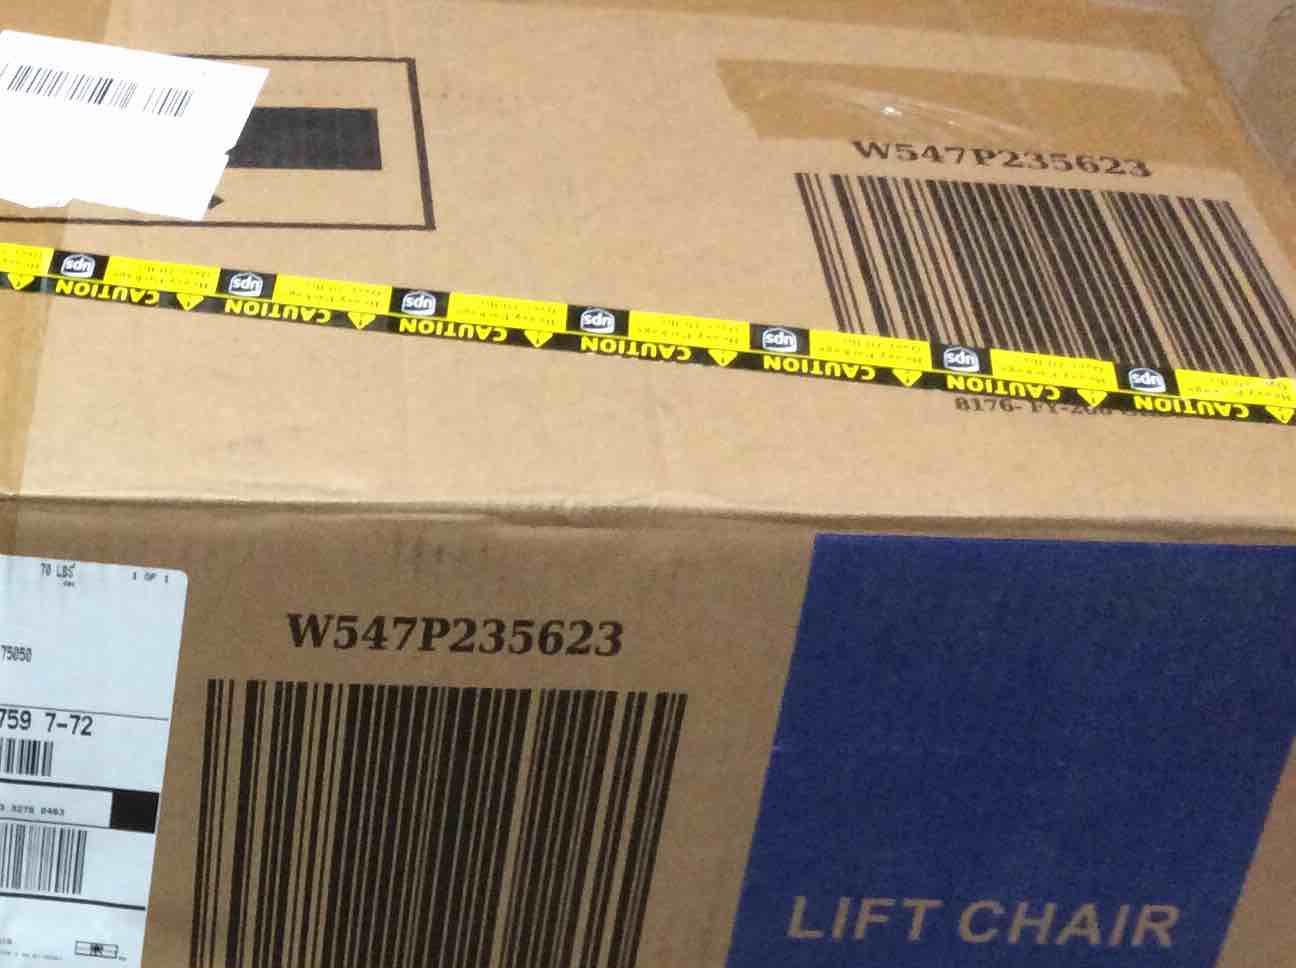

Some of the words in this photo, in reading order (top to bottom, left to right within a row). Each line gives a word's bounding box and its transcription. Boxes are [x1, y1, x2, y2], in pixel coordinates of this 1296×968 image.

[851, 140, 1152, 178] W547P235623
[55, 278, 161, 305] CAUTION
[224, 299, 332, 324] CAUTION
[399, 318, 509, 342] CAUTION
[580, 336, 693, 362] CAUTION
[763, 355, 877, 381] CAUTION
[947, 375, 1061, 401] CAUTION
[1133, 396, 1251, 418] CAUTION
[287, 613, 624, 657] W547P235623
[45, 712, 95, 737] 7-72
[786, 896, 943, 943] LIFT
[958, 900, 1181, 948] CHAIR
